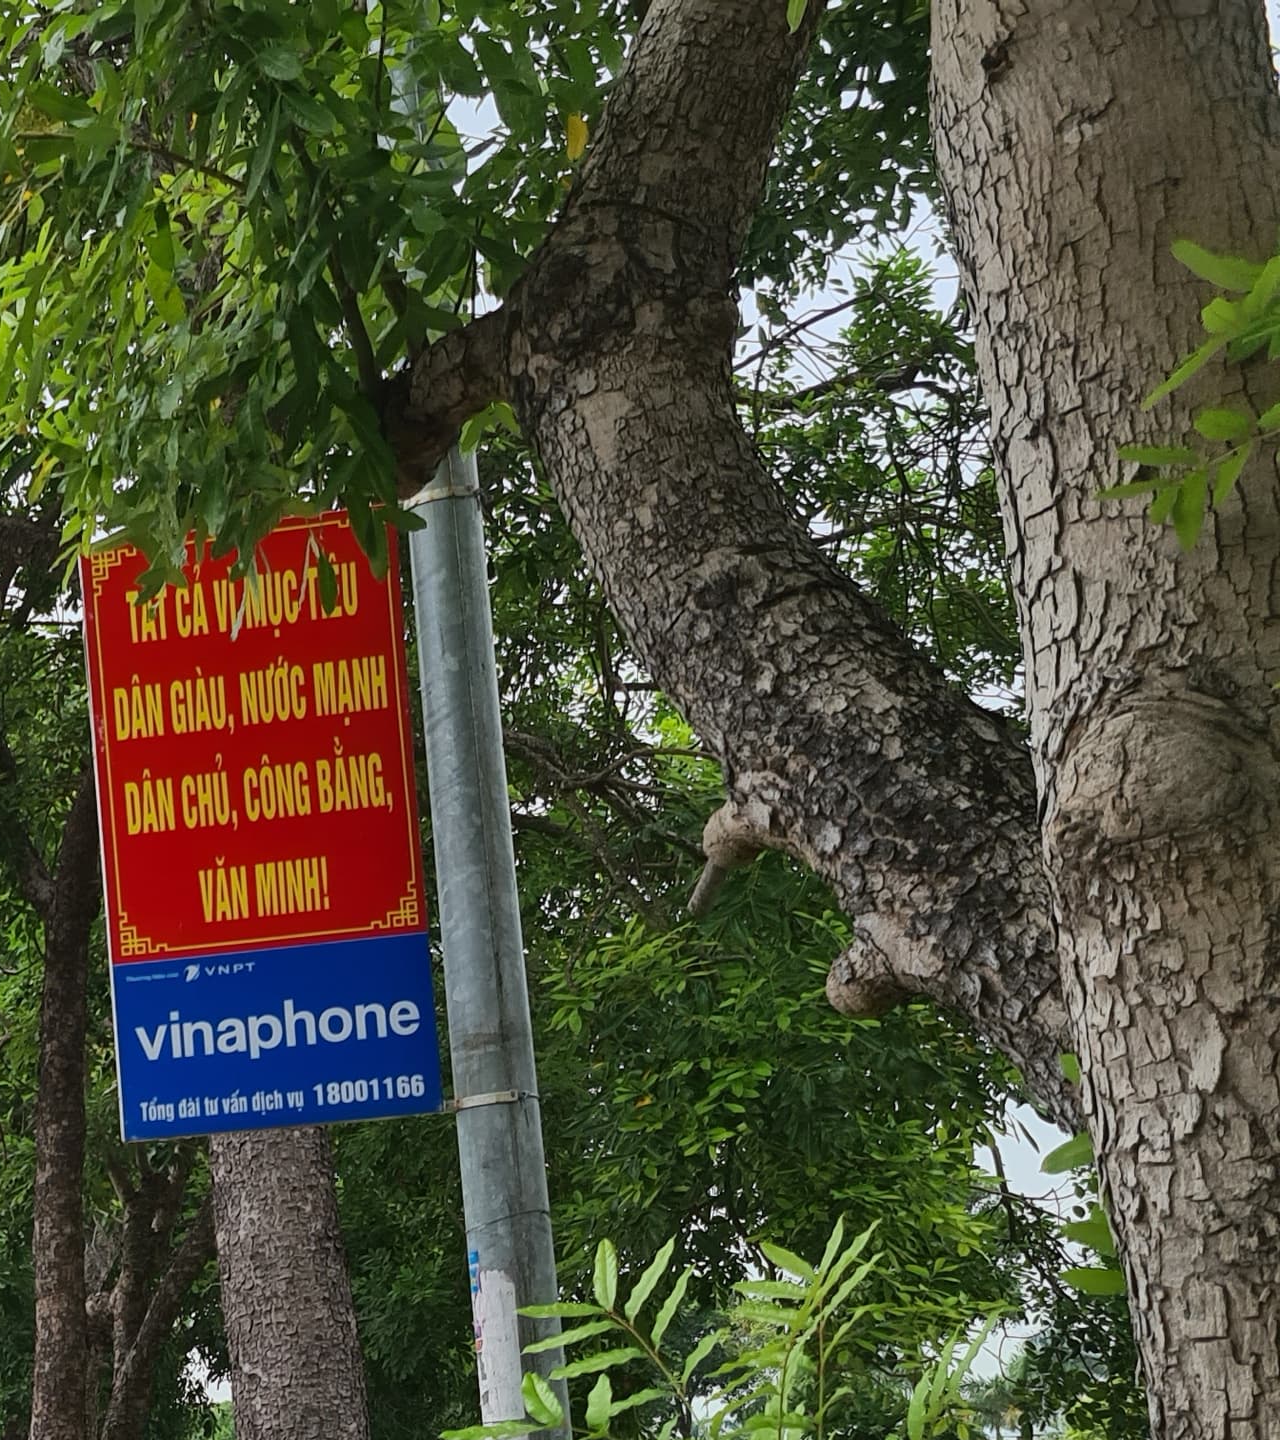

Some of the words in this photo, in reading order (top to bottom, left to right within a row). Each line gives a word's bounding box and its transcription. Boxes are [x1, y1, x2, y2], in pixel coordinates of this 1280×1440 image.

[175, 564, 209, 638] CẢ
[244, 569, 299, 638] MỤC
[306, 553, 358, 620] TÊU
[113, 674, 165, 741] DÂN
[170, 666, 234, 735] GIÀU,
[240, 656, 307, 726] NƯỚC
[313, 655, 388, 726] MẠNH
[124, 768, 176, 835] DÂN
[181, 753, 238, 831] CHỦ,
[243, 754, 311, 822] CÔNG
[316, 736, 393, 813] BẰNG,
[198, 856, 249, 923] VĂN
[255, 856, 330, 917] MINH!
[204, 961, 256, 977] VNPT
[135, 999, 421, 1061] vinaphone
[139, 1096, 175, 1122] Tổng
[178, 1097, 201, 1119] đài
[204, 1096, 219, 1116] tư
[222, 1088, 248, 1115] vấn
[252, 1089, 283, 1116] dịch
[287, 1090, 305, 1112] vụ
[313, 1074, 425, 1107] 18001166
